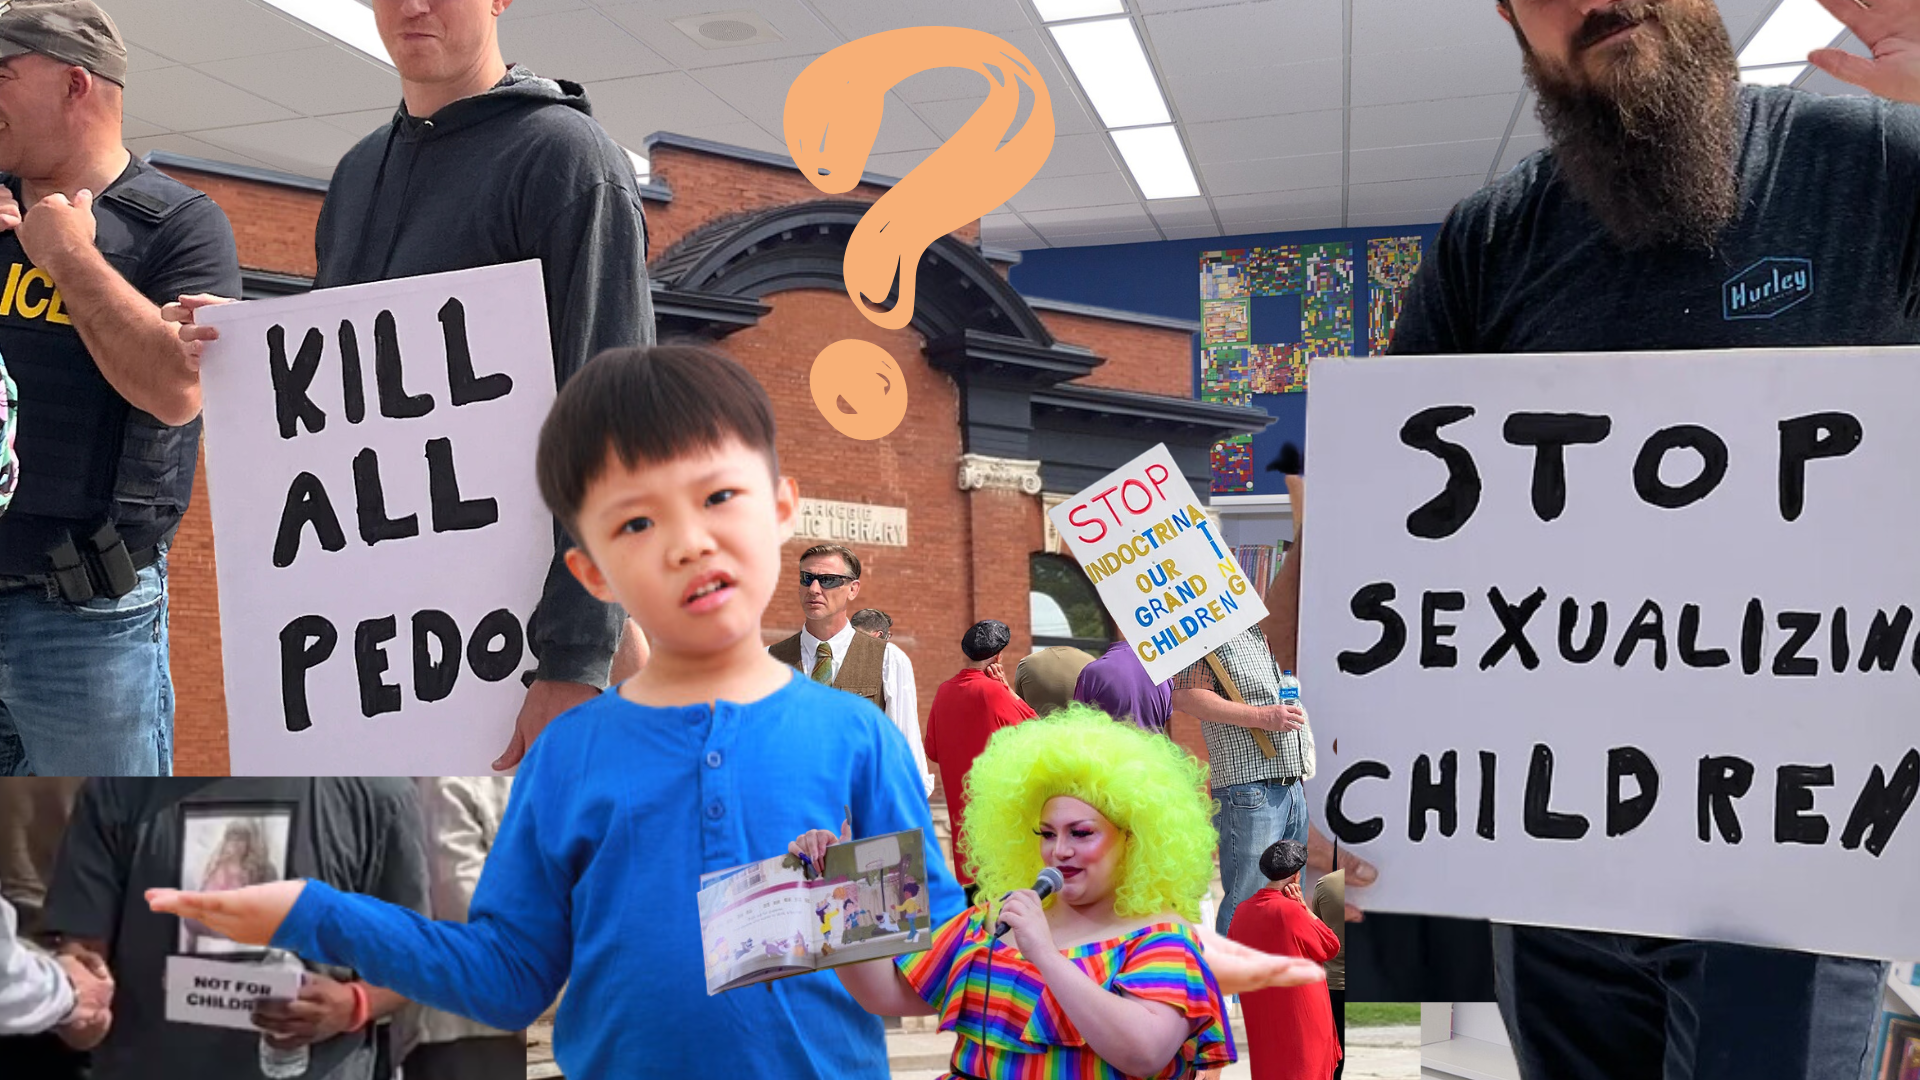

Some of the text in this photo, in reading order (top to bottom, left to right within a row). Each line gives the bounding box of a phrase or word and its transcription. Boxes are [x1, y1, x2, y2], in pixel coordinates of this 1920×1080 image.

[1731, 268, 1807, 310] Hurley
[267, 297, 513, 440] KILL
[273, 437, 499, 568] ALL
[1068, 463, 1169, 544] STOP
[1400, 405, 1863, 539] STOP
[802, 502, 872, 521] ARNEGIE
[829, 519, 905, 545] LIBRARY
[1135, 558, 1182, 594] OUR
[1135, 574, 1208, 628] GRAND
[1137, 590, 1239, 662] CHILDREN
[1337, 582, 1920, 677] SEXUALIZIN
[1325, 743, 1920, 858] CHILDREN
[186, 993, 255, 1012] CHILDR
[194, 976, 272, 996] NOT FOR
